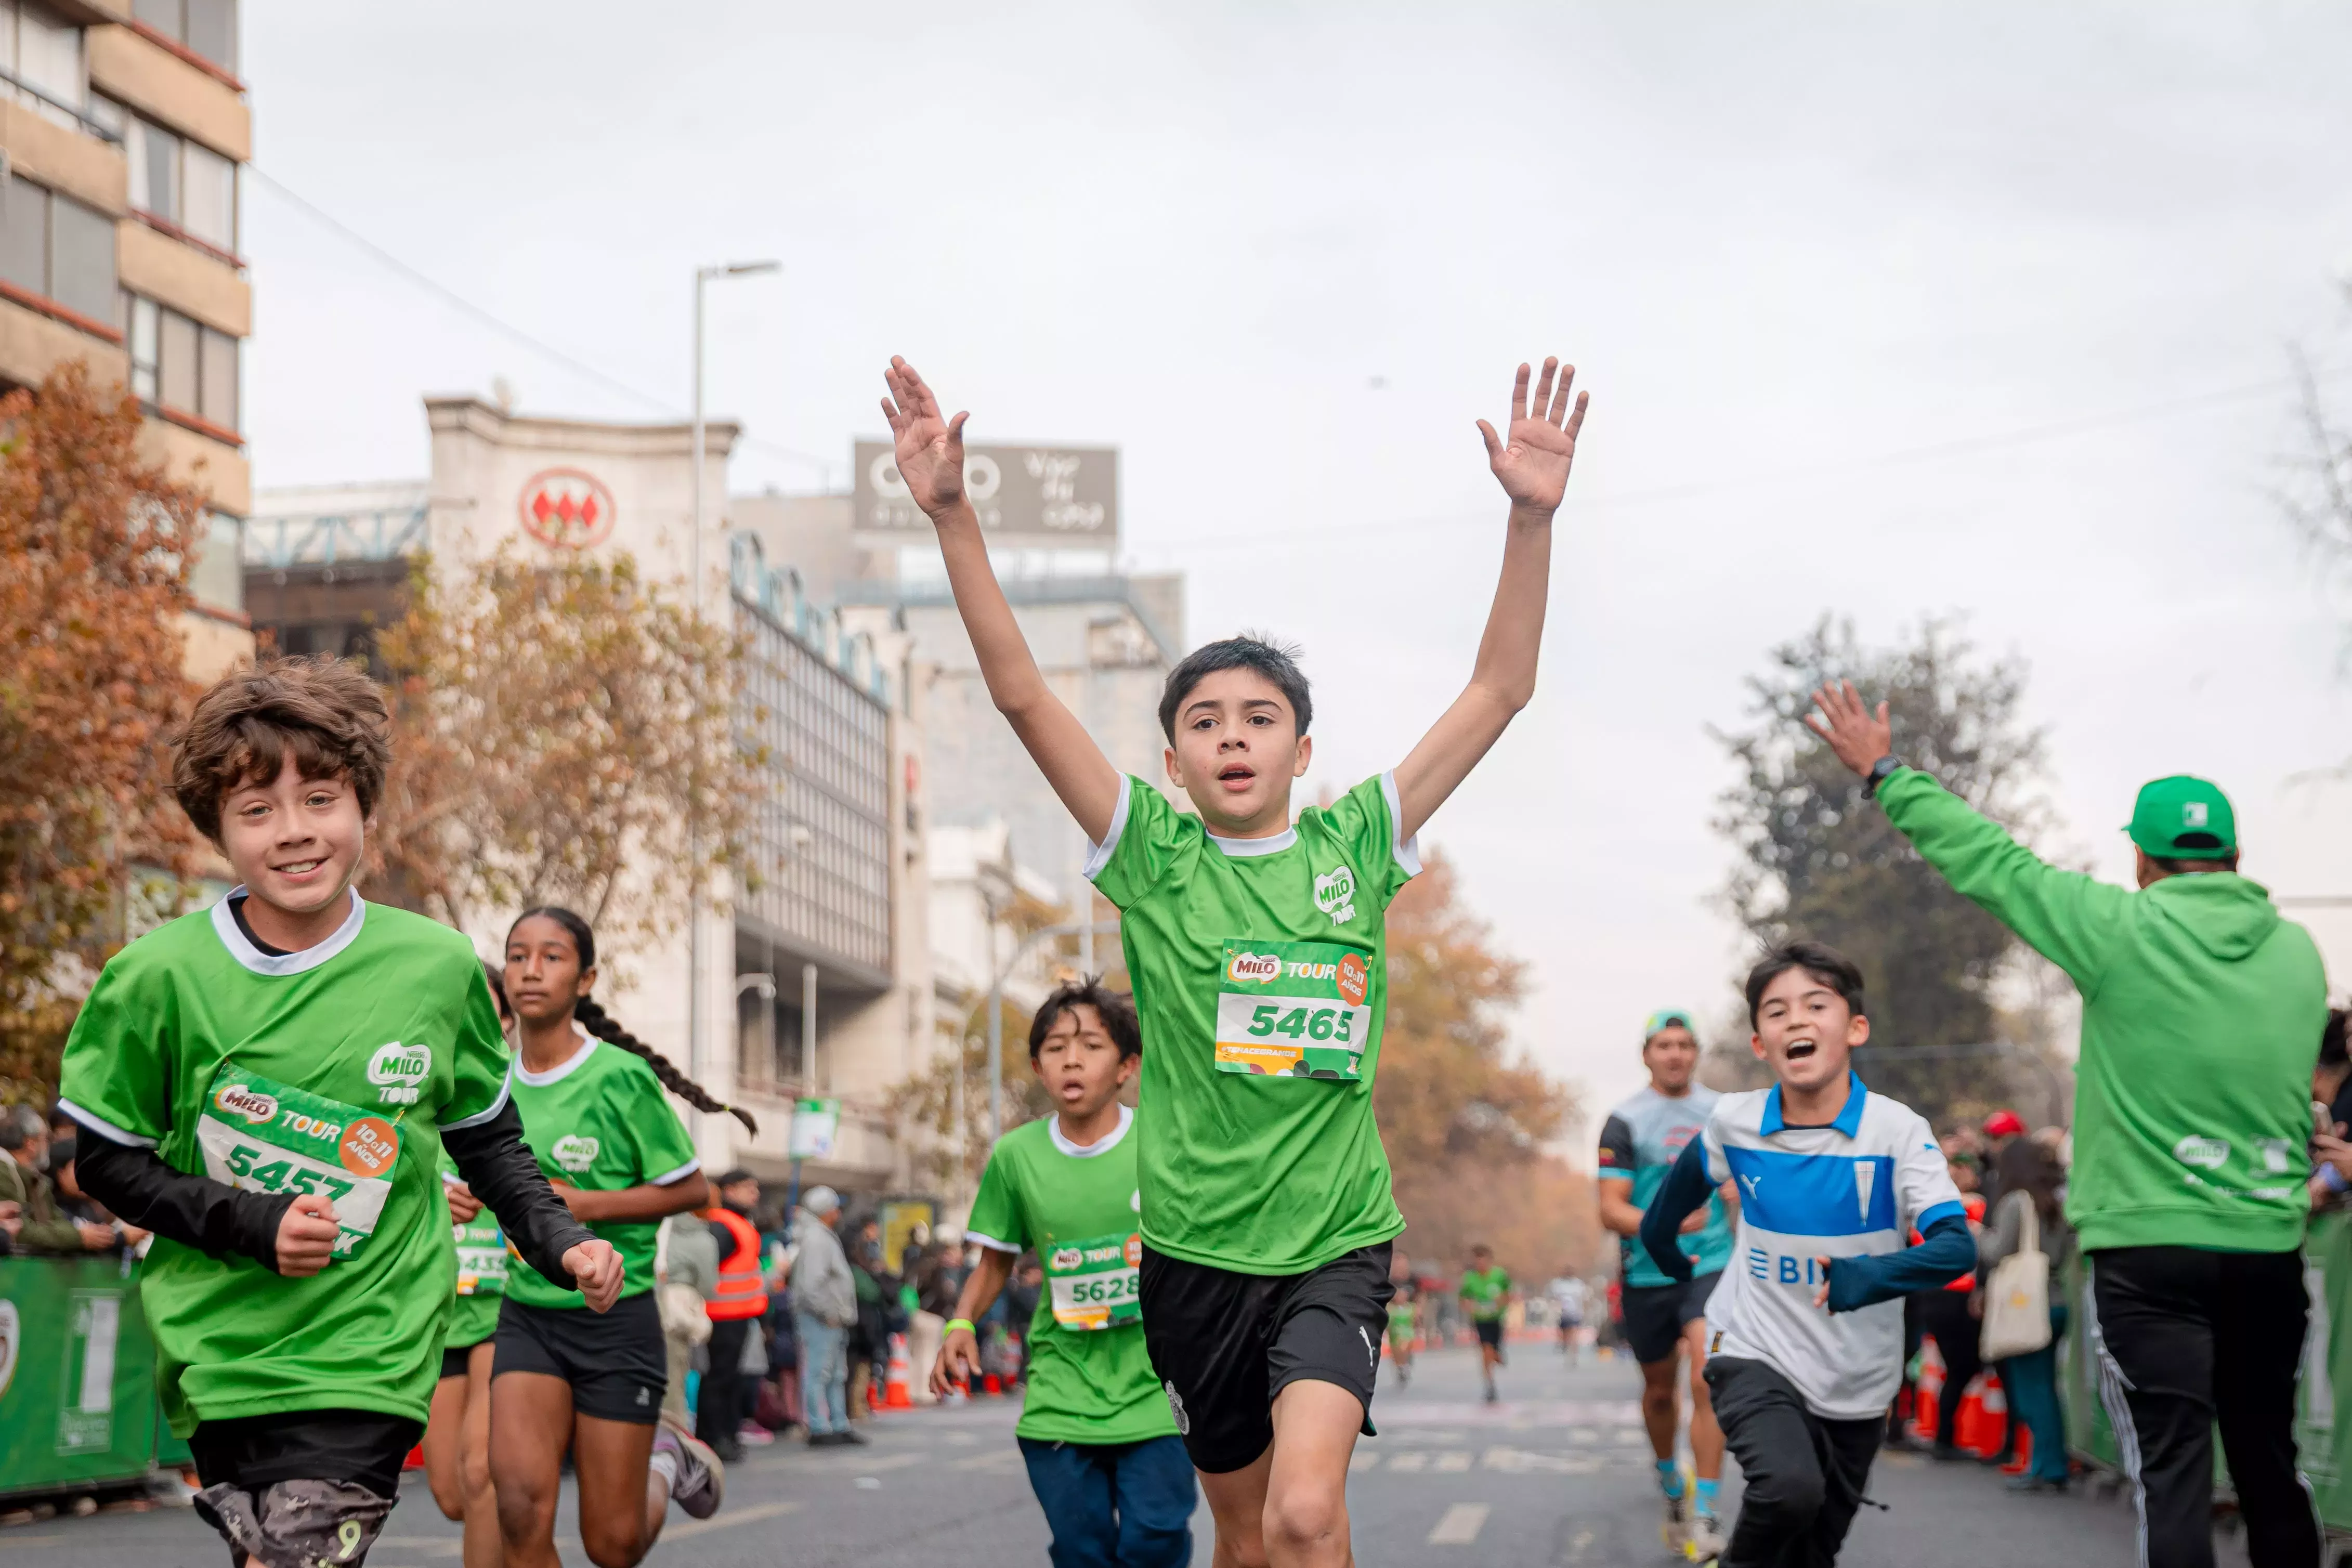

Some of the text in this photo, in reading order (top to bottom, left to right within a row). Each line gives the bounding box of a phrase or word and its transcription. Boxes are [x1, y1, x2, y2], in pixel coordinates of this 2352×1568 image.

[869, 451, 1001, 500] OO
[1319, 879, 1350, 905] MILO
[1330, 904, 1356, 926] TOUR
[1237, 960, 1337, 979] MILO TOUR
[1341, 979, 1362, 997] AÑOS
[1247, 1005, 1354, 1042] 5465
[380, 1056, 425, 1075] MILO
[379, 1087, 419, 1103] TOUR
[225, 1091, 342, 1143] MILO TOUR
[345, 1140, 381, 1169] AÑOS
[562, 1144, 594, 1155] MILO
[225, 1144, 356, 1202] 5457
[1084, 1246, 1121, 1264] TOUR
[1073, 1274, 1140, 1302] 5628
